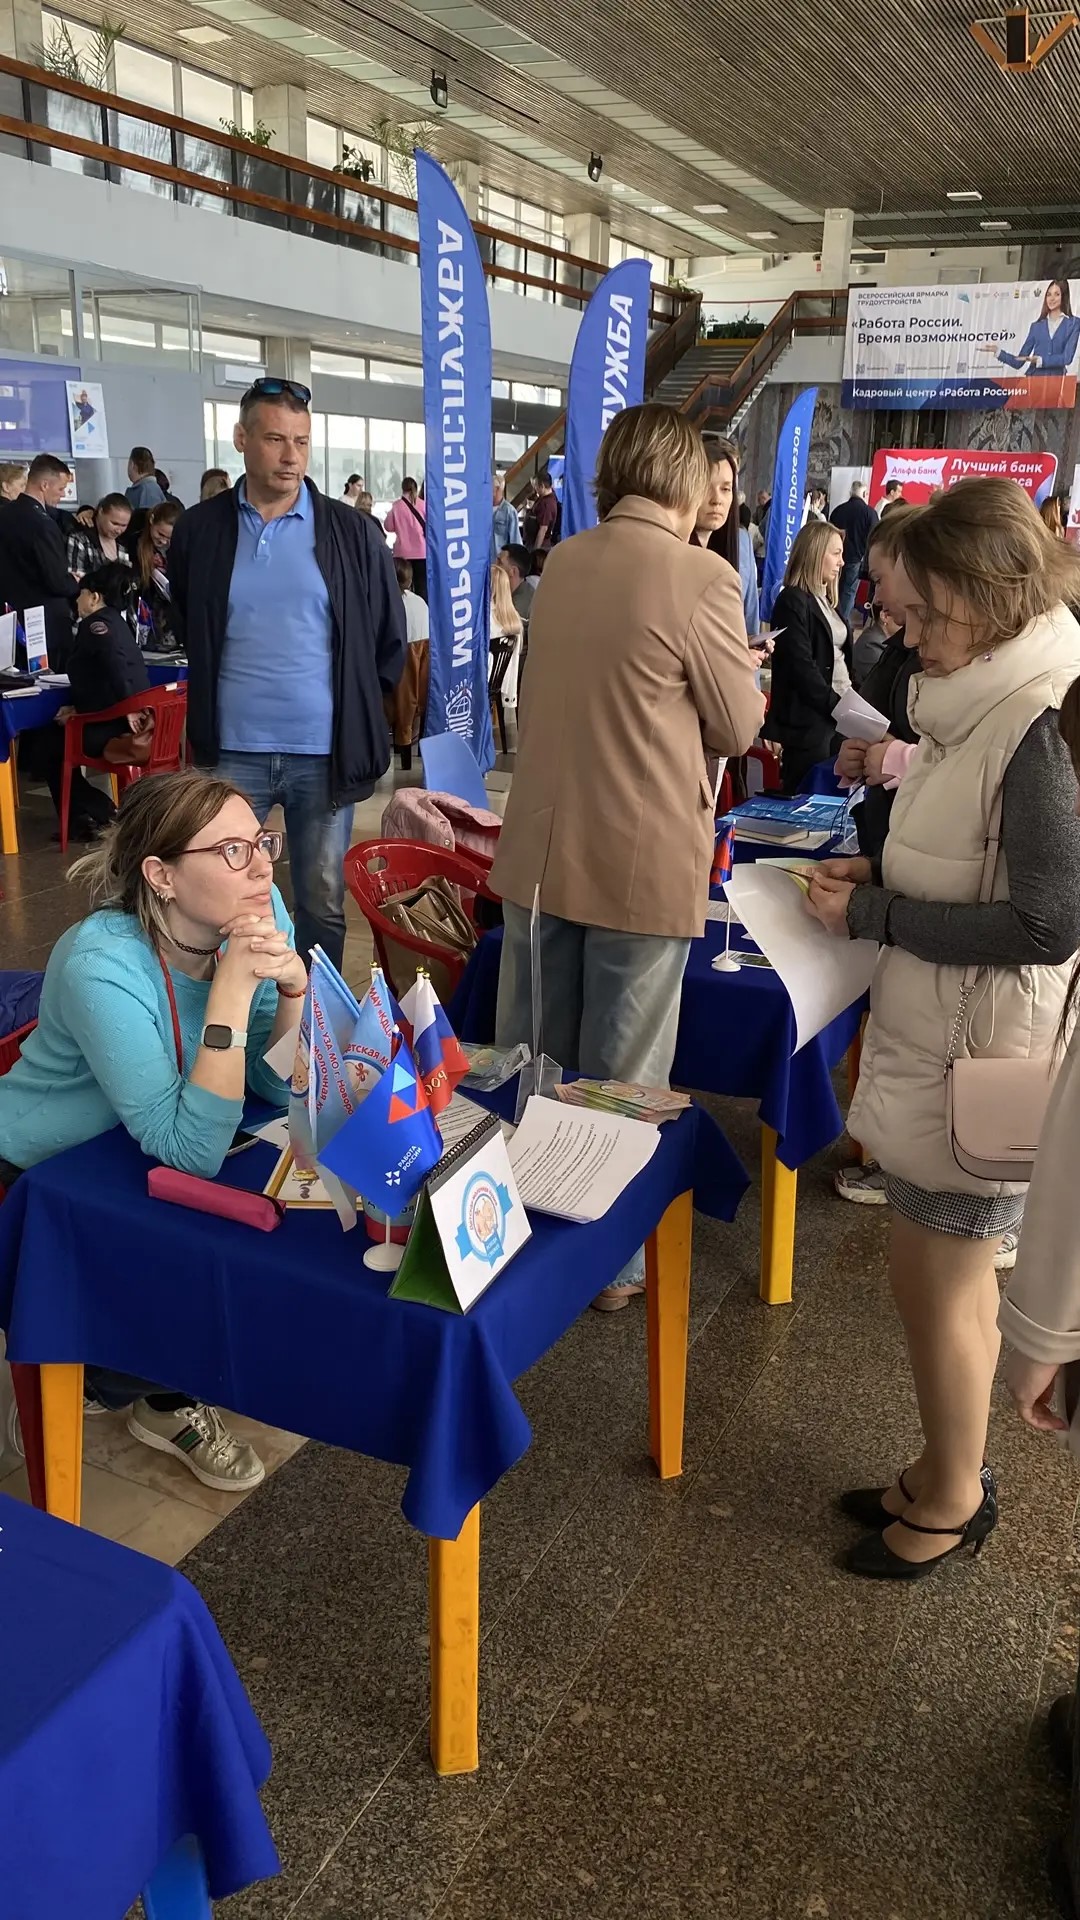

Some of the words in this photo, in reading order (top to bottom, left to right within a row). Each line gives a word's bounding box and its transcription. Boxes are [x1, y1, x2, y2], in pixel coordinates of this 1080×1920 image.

[858, 291, 914, 300] ВСЕРОССИЙСКАЯ
[851, 317, 905, 329] «Работа
[909, 316, 963, 329] России.
[858, 333, 901, 345] Время
[905, 329, 1016, 344] возможностей»
[852, 387, 903, 399] Кадровый
[905, 388, 937, 399] центр
[939, 387, 981, 397] «Работа
[983, 386, 1028, 396] России»
[951, 458, 1007, 474] Лучший
[1010, 460, 1043, 473] банк
[369, 987, 382, 1008] МАУ
[397, 1145, 417, 1168] РАБОТА
[402, 1147, 423, 1171] РОССИИ
